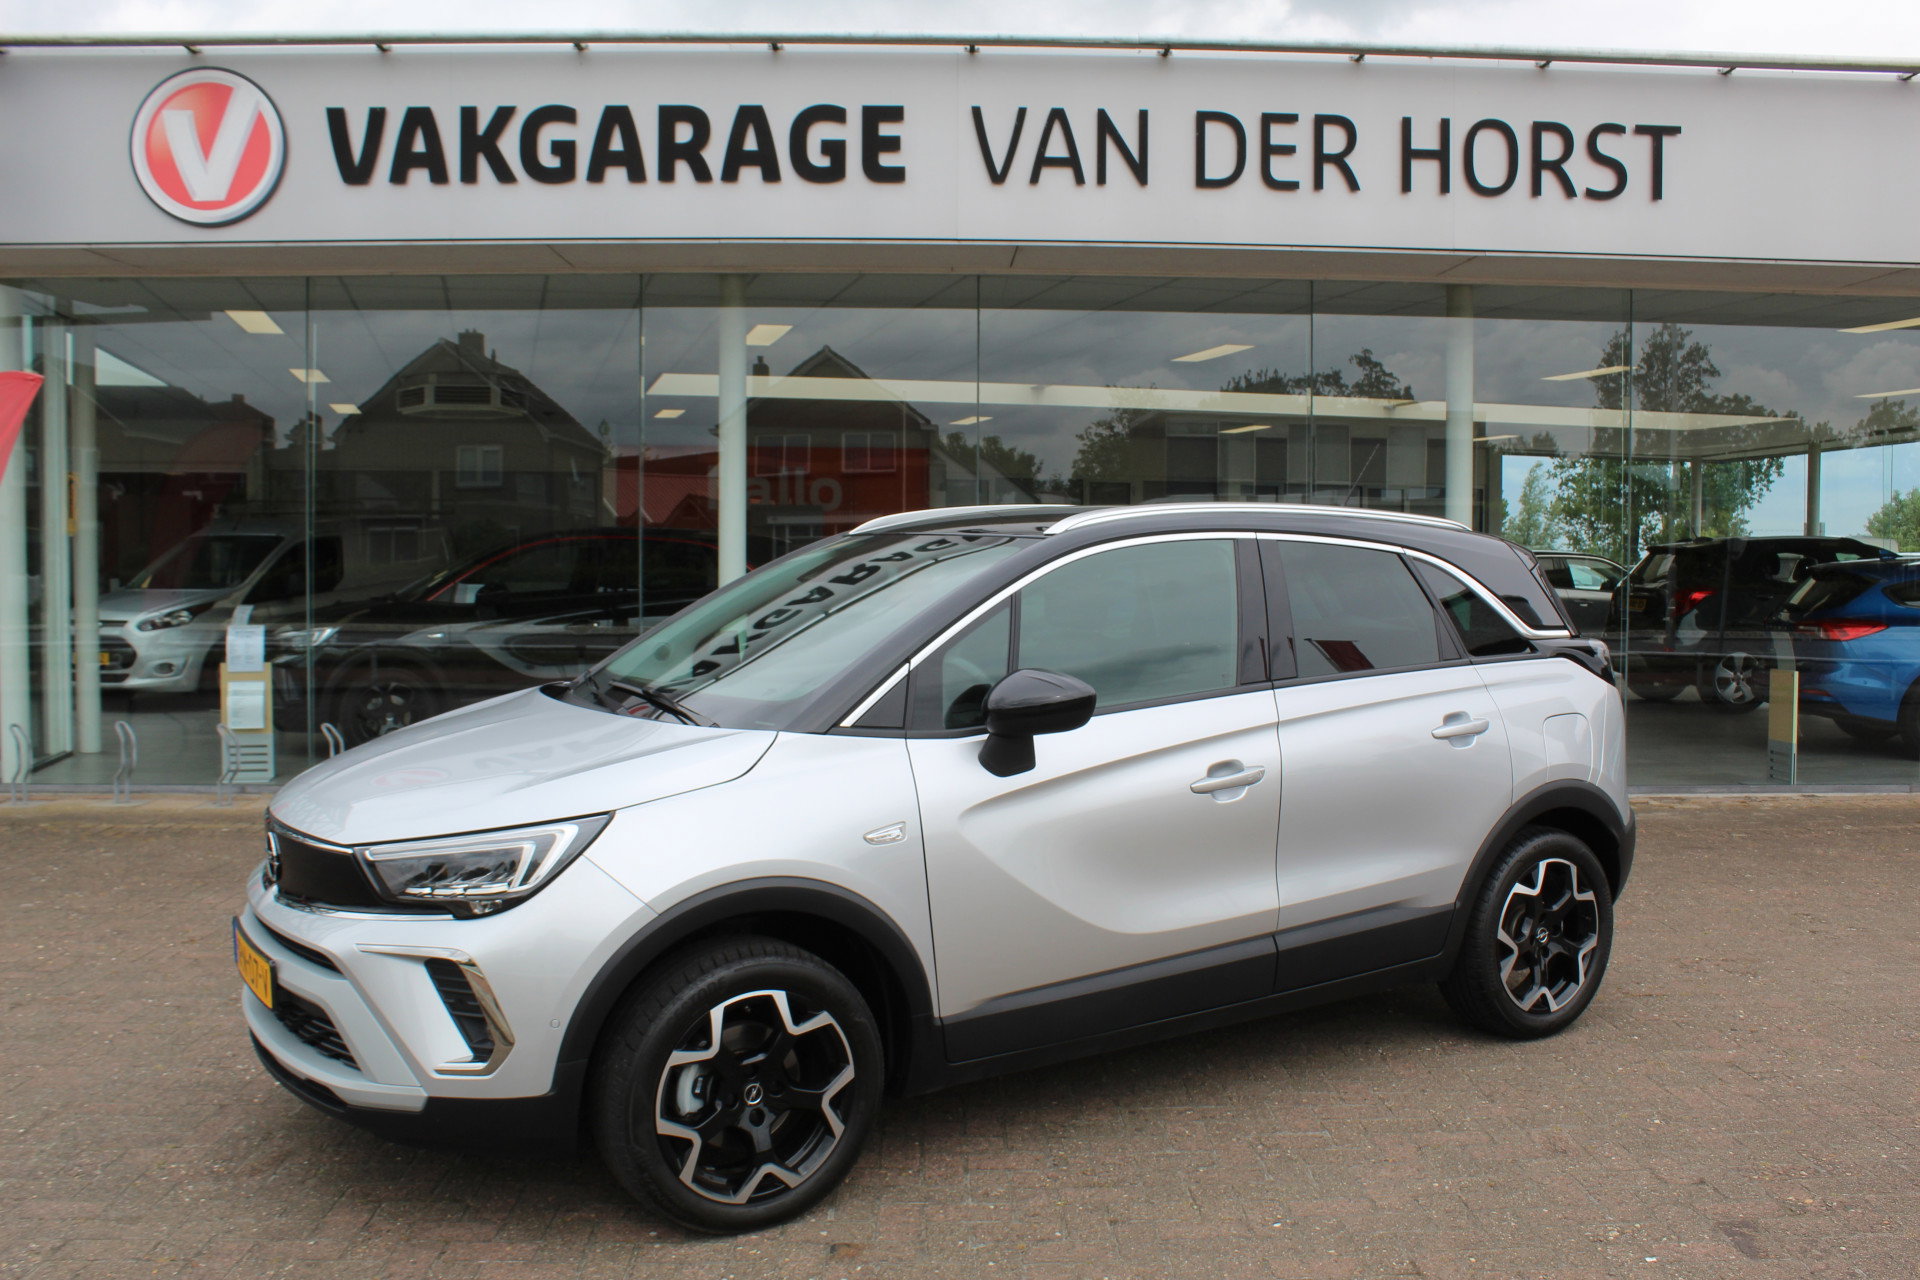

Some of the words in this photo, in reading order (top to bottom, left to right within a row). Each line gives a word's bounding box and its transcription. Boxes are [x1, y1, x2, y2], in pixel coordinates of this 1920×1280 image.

[162, 86, 264, 201] V
[326, 104, 906, 185] VAKGARAGE
[971, 105, 1149, 187] VAN
[1195, 110, 1361, 192] DER
[1401, 116, 1682, 201] HORST
